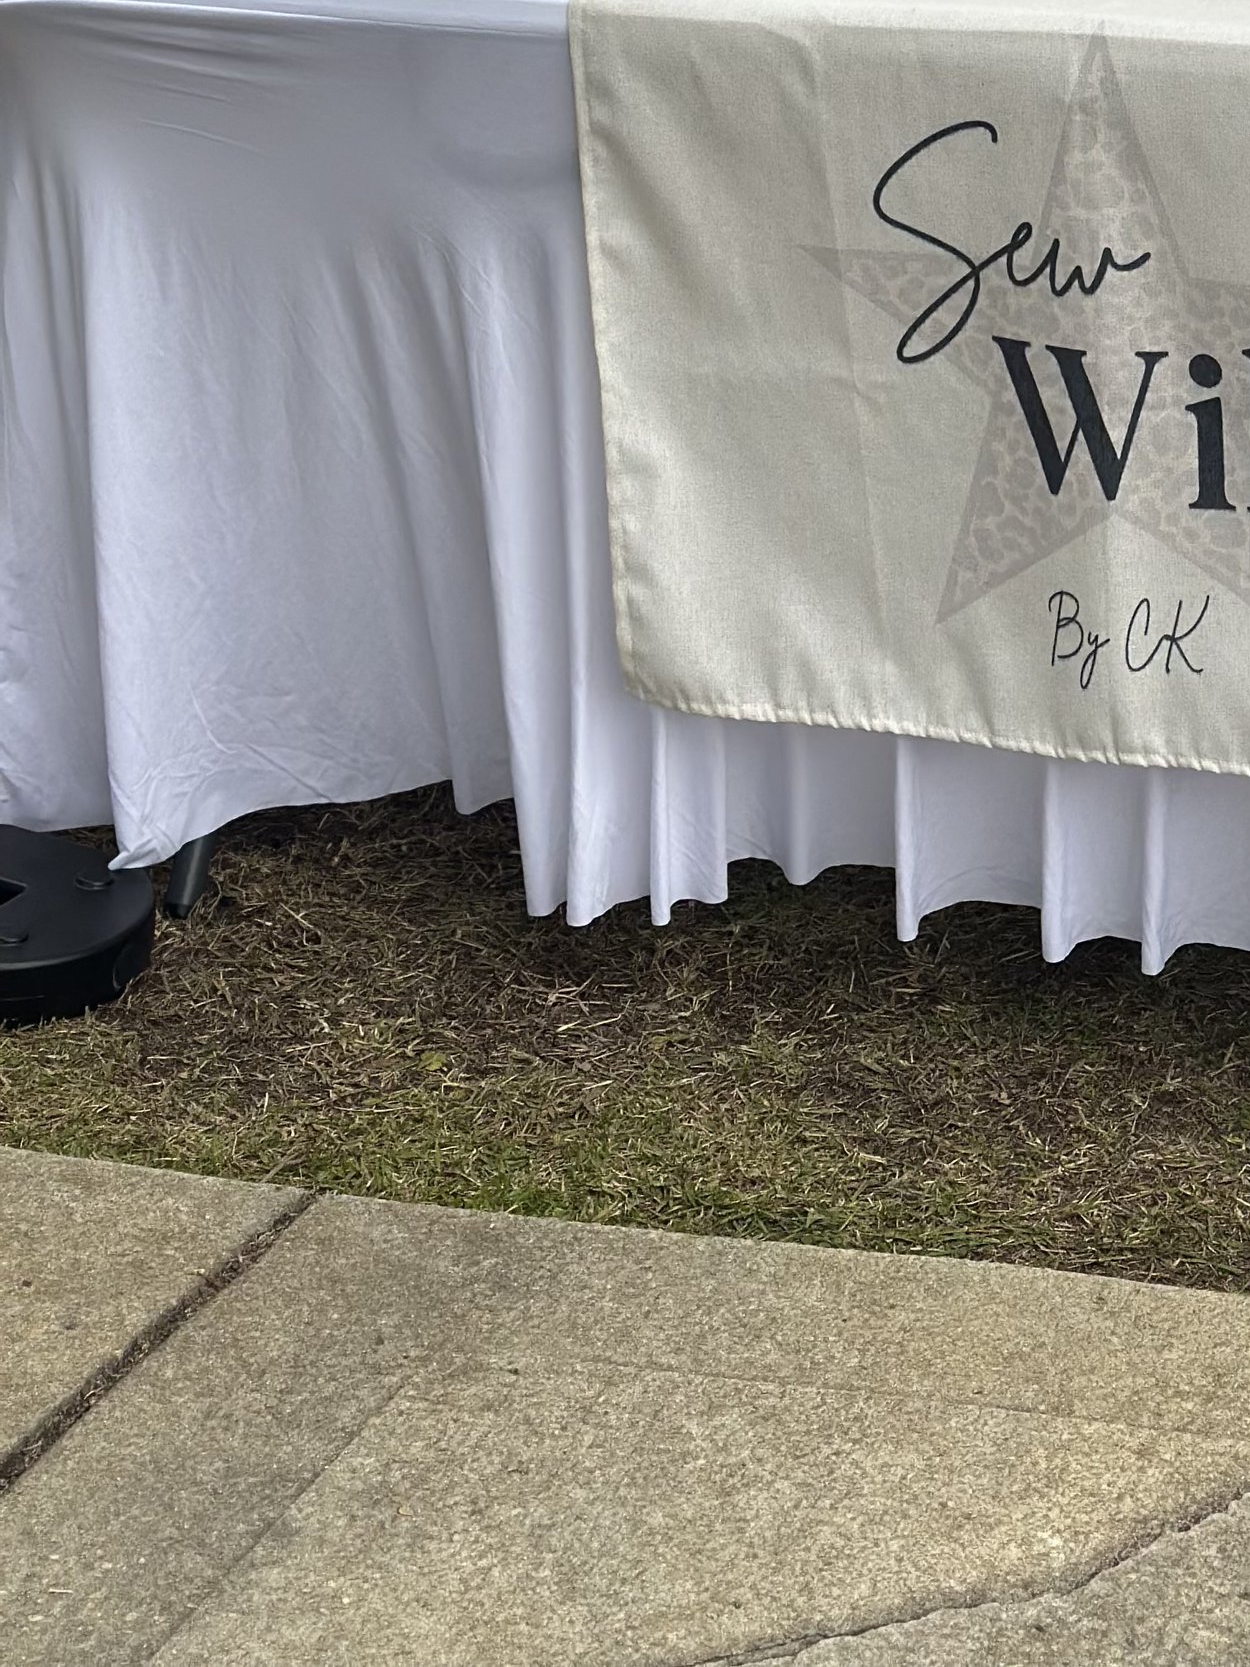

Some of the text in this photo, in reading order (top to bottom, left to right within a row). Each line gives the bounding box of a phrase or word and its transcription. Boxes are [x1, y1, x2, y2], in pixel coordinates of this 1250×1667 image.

[873, 120, 1151, 364] Sew
[1048, 590, 1210, 690] By CK
